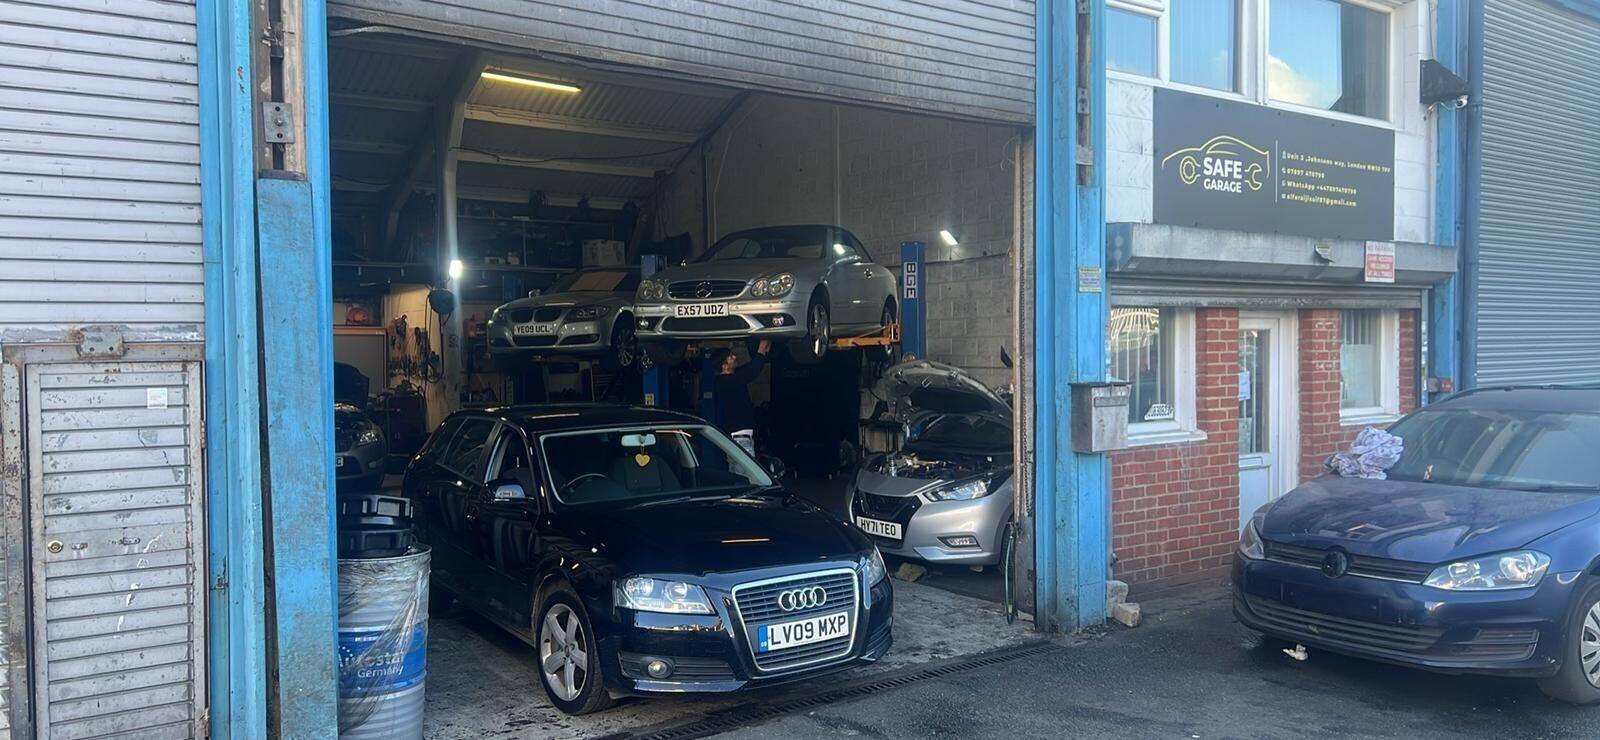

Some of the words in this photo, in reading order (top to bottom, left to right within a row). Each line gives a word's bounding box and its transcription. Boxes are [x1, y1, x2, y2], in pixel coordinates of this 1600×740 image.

[1203, 157, 1242, 179] SAFE
[1203, 178, 1242, 193] GARAGE
[677, 305, 702, 316] EX57
[704, 304, 724, 315] UDZ
[516, 325, 534, 333] YE09
[535, 325, 550, 333] UCL
[860, 518, 878, 533] HY71
[879, 522, 896, 536] TEO
[770, 621, 814, 646] LV09
[818, 615, 846, 637] MXP
[357, 665, 404, 678] Germany
